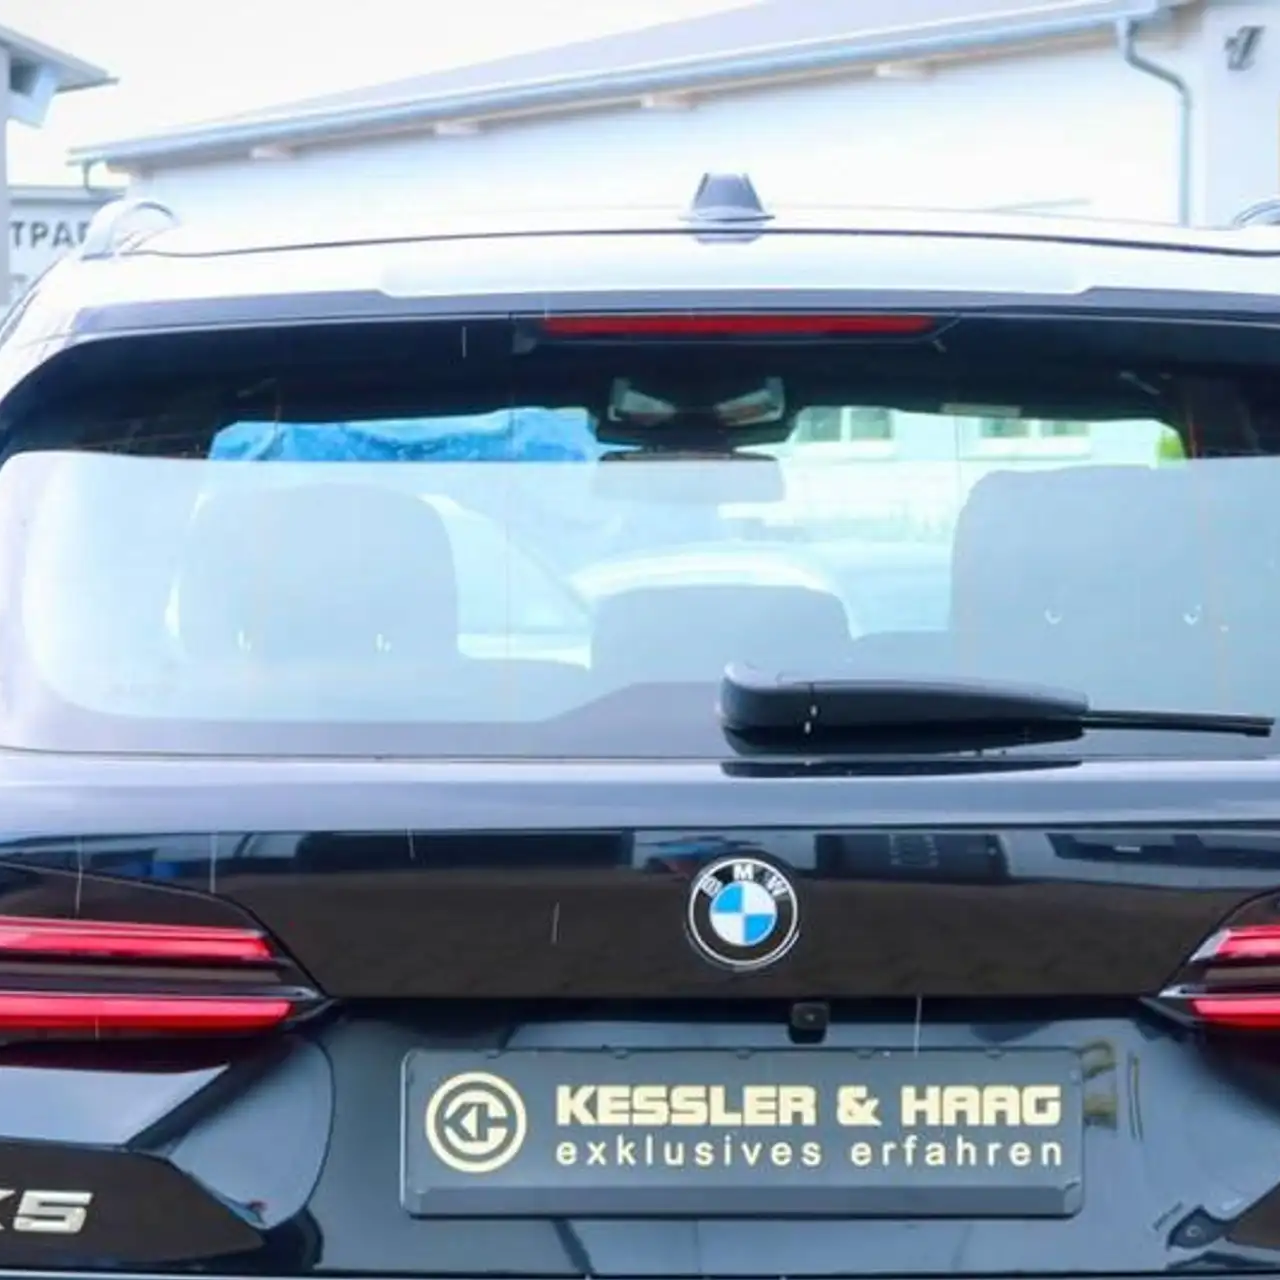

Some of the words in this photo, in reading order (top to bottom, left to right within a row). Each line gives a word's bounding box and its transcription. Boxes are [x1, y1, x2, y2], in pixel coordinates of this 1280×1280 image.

[556, 1084, 817, 1126] KESSLER
[836, 1084, 882, 1126] &
[900, 1084, 1062, 1126] HAAG
[556, 1134, 822, 1167] exklusives
[851, 1134, 1062, 1167] erfahren
